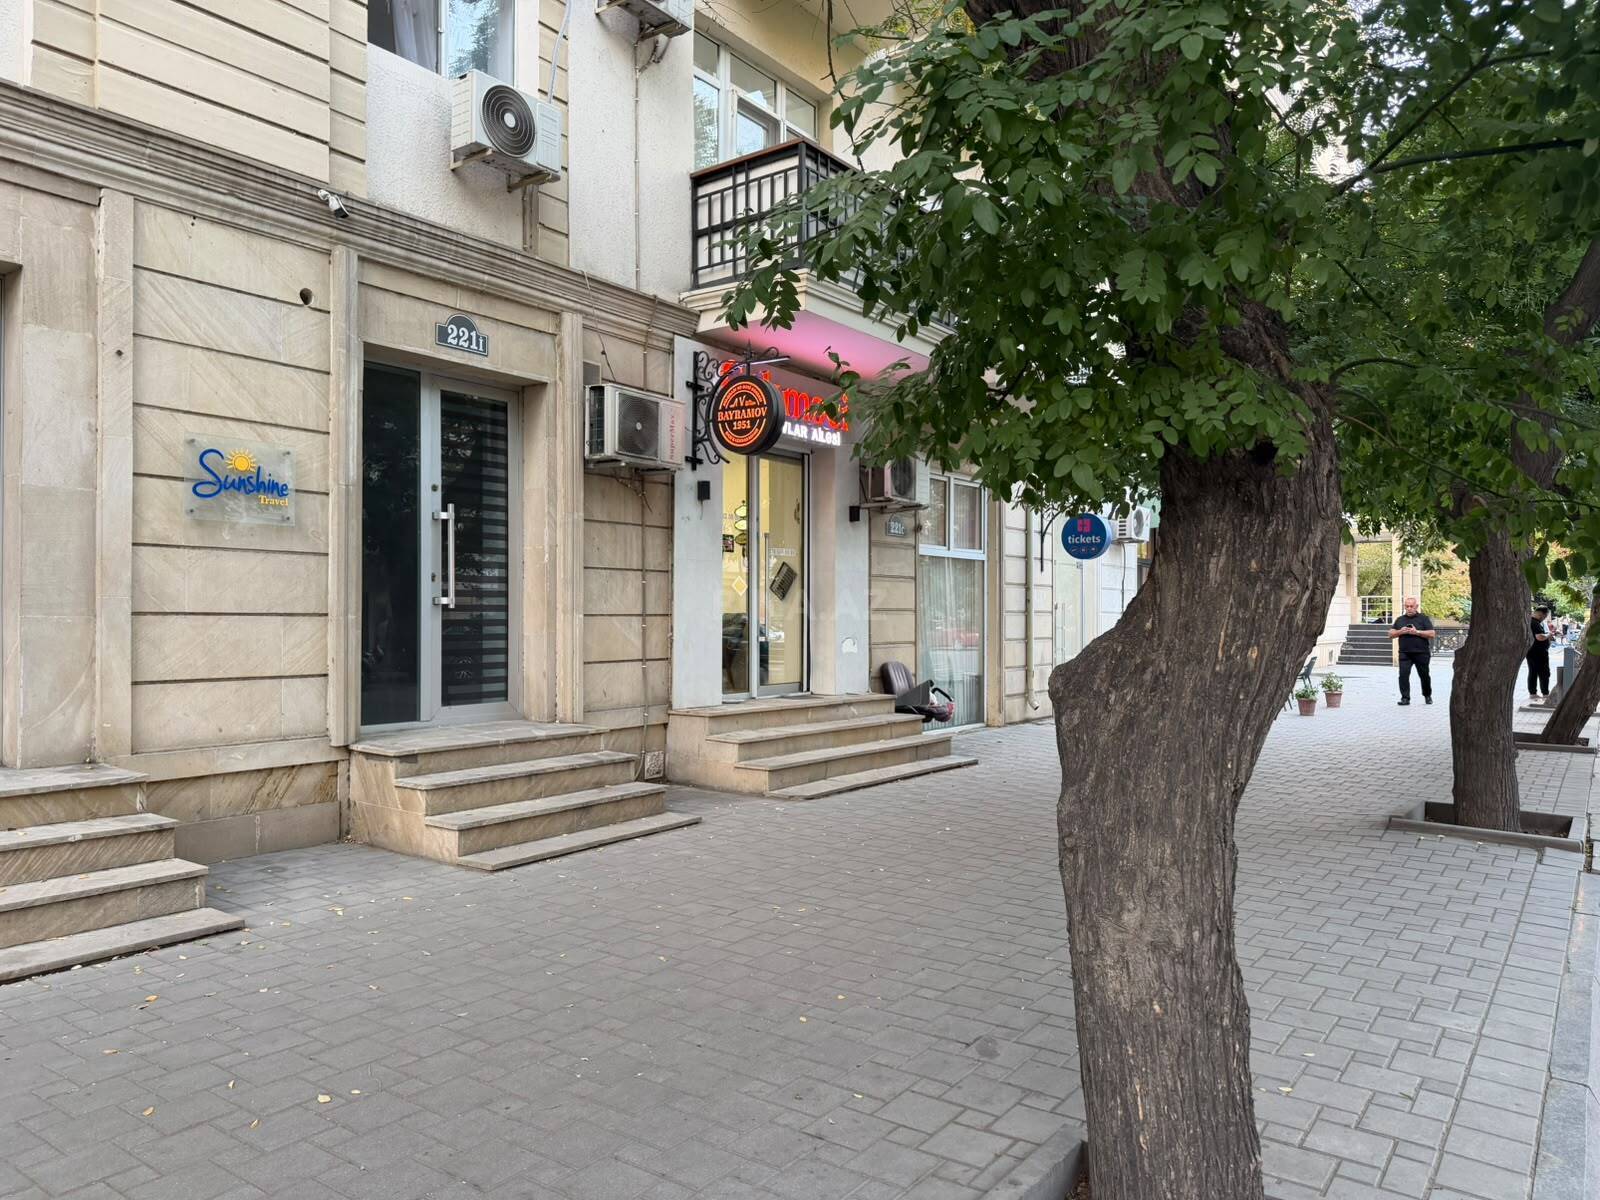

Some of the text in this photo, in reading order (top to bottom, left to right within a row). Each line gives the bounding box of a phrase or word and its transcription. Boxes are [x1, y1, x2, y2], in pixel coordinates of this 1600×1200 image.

[717, 406, 768, 422] BAYRAMOV
[732, 420, 751, 430] 1951
[192, 448, 289, 498] Sunshine
[258, 495, 289, 507] Travel
[1067, 534, 1101, 545] tickets
